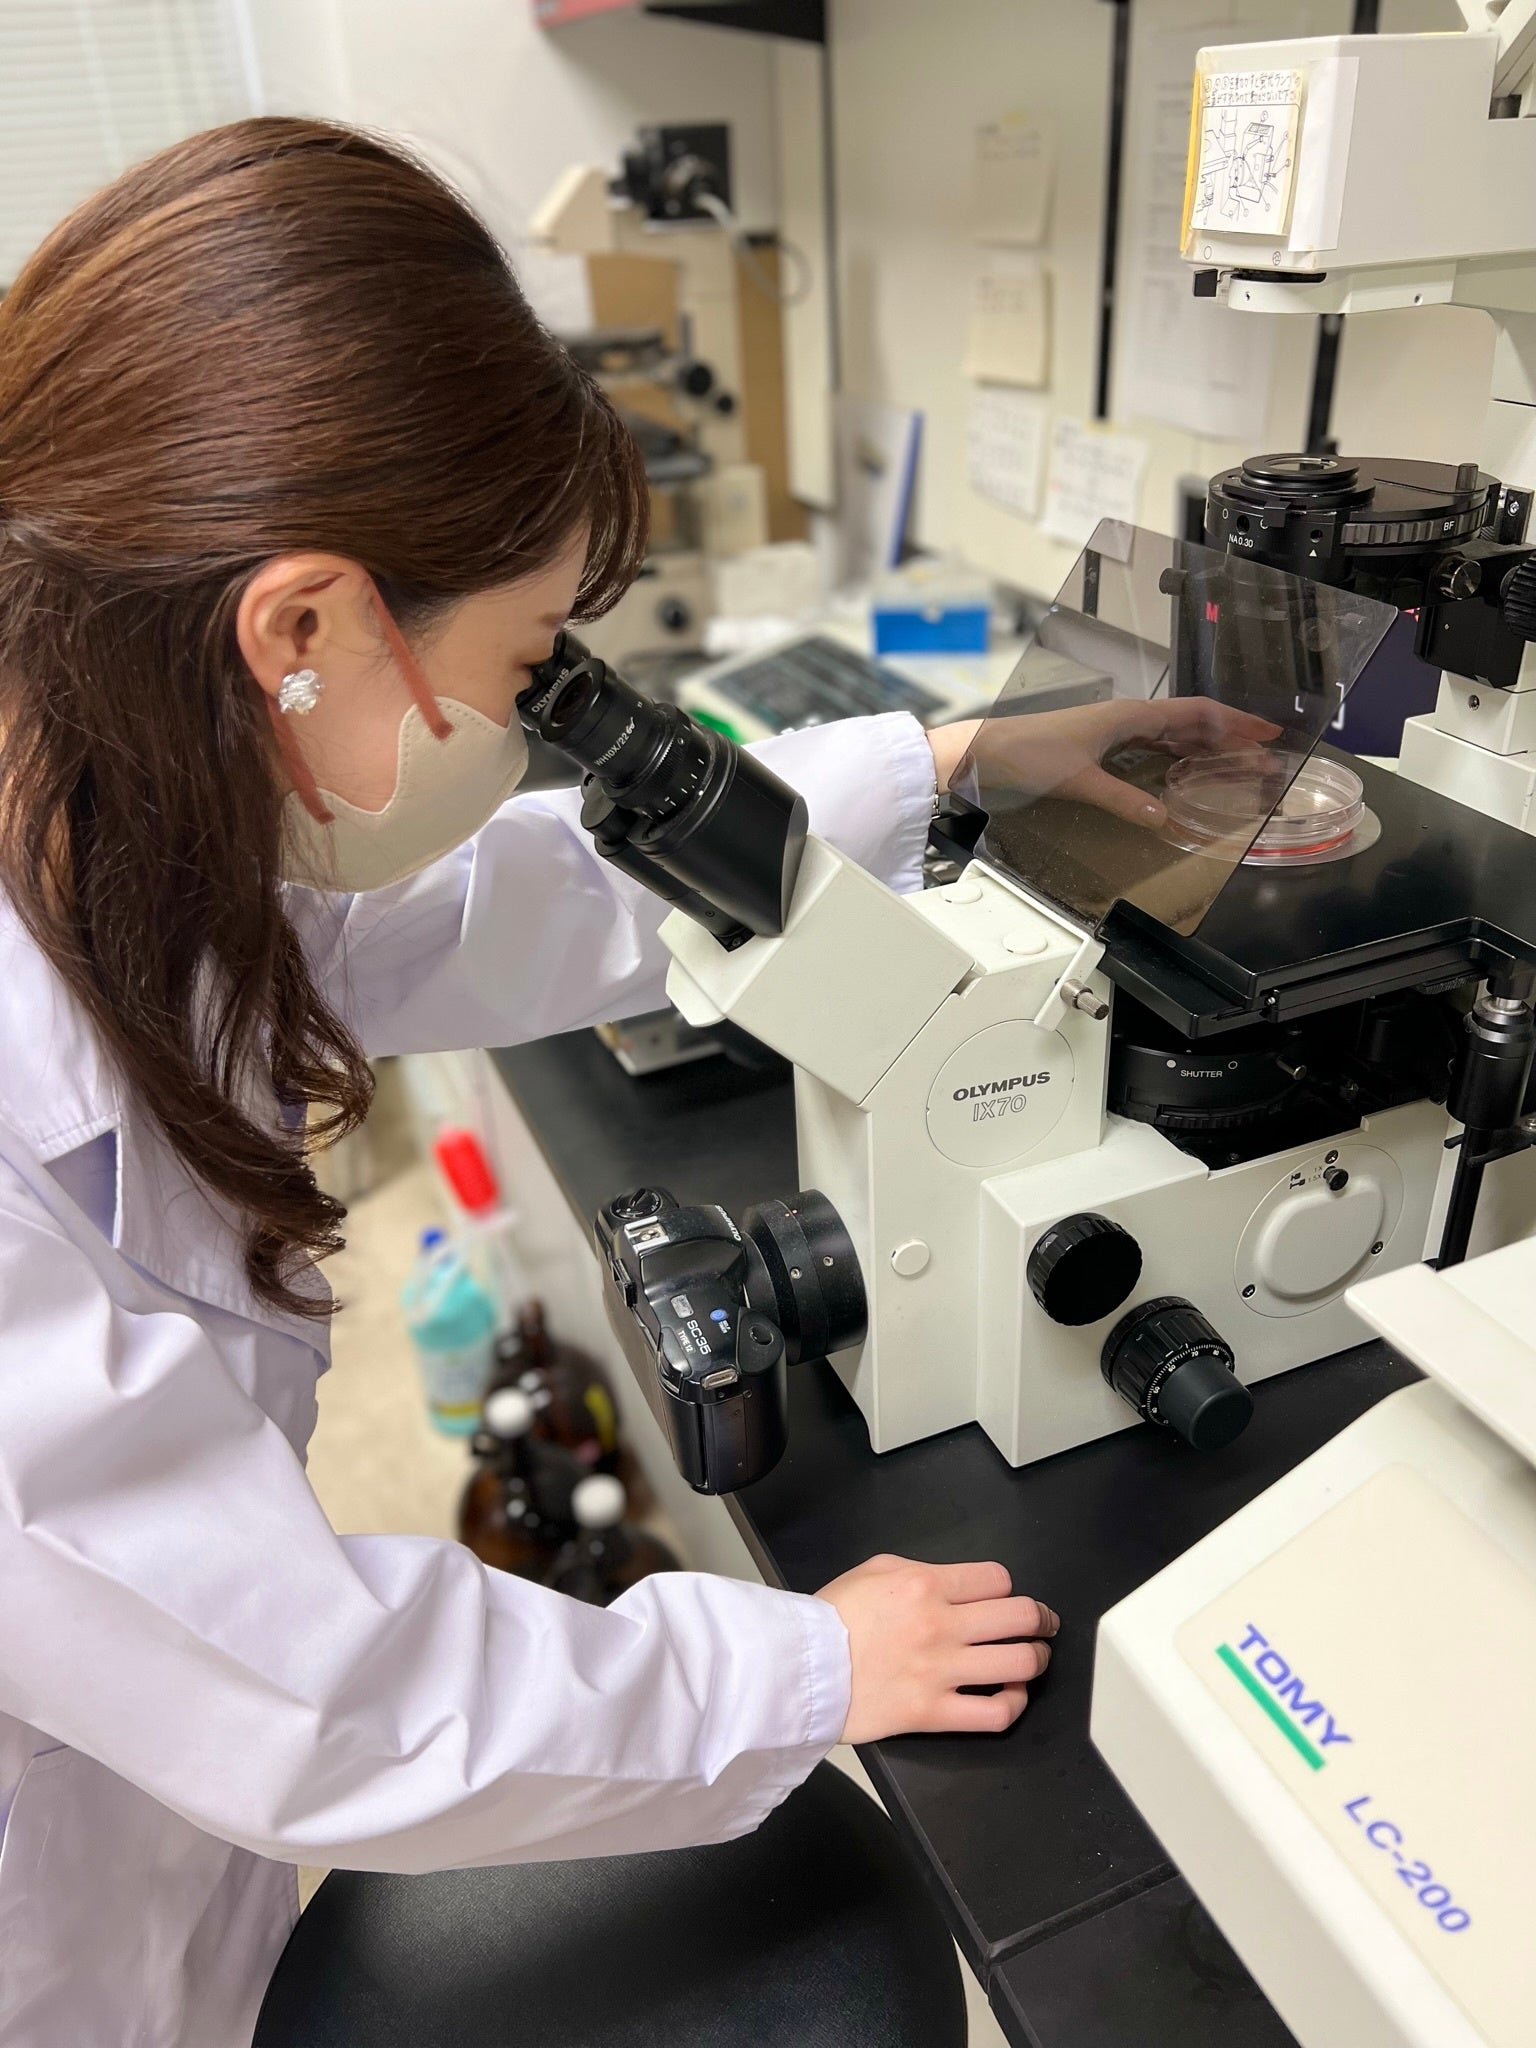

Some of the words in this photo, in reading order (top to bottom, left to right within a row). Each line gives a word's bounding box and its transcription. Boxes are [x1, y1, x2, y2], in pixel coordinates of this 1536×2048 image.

[1228, 533, 1238, 545] NA
[1238, 536, 1254, 548] 0.30
[1443, 521, 1455, 531] BF
[531, 667, 569, 713] OLYMPUS
[952, 1071, 1051, 1102] OLYMPUS
[1180, 1069, 1223, 1078] SHUTTER
[973, 1093, 1027, 1122] IX70
[686, 1319, 712, 1355] SC35
[1239, 1623, 1354, 1747] TOMY
[1343, 1795, 1471, 1933] LC-200
